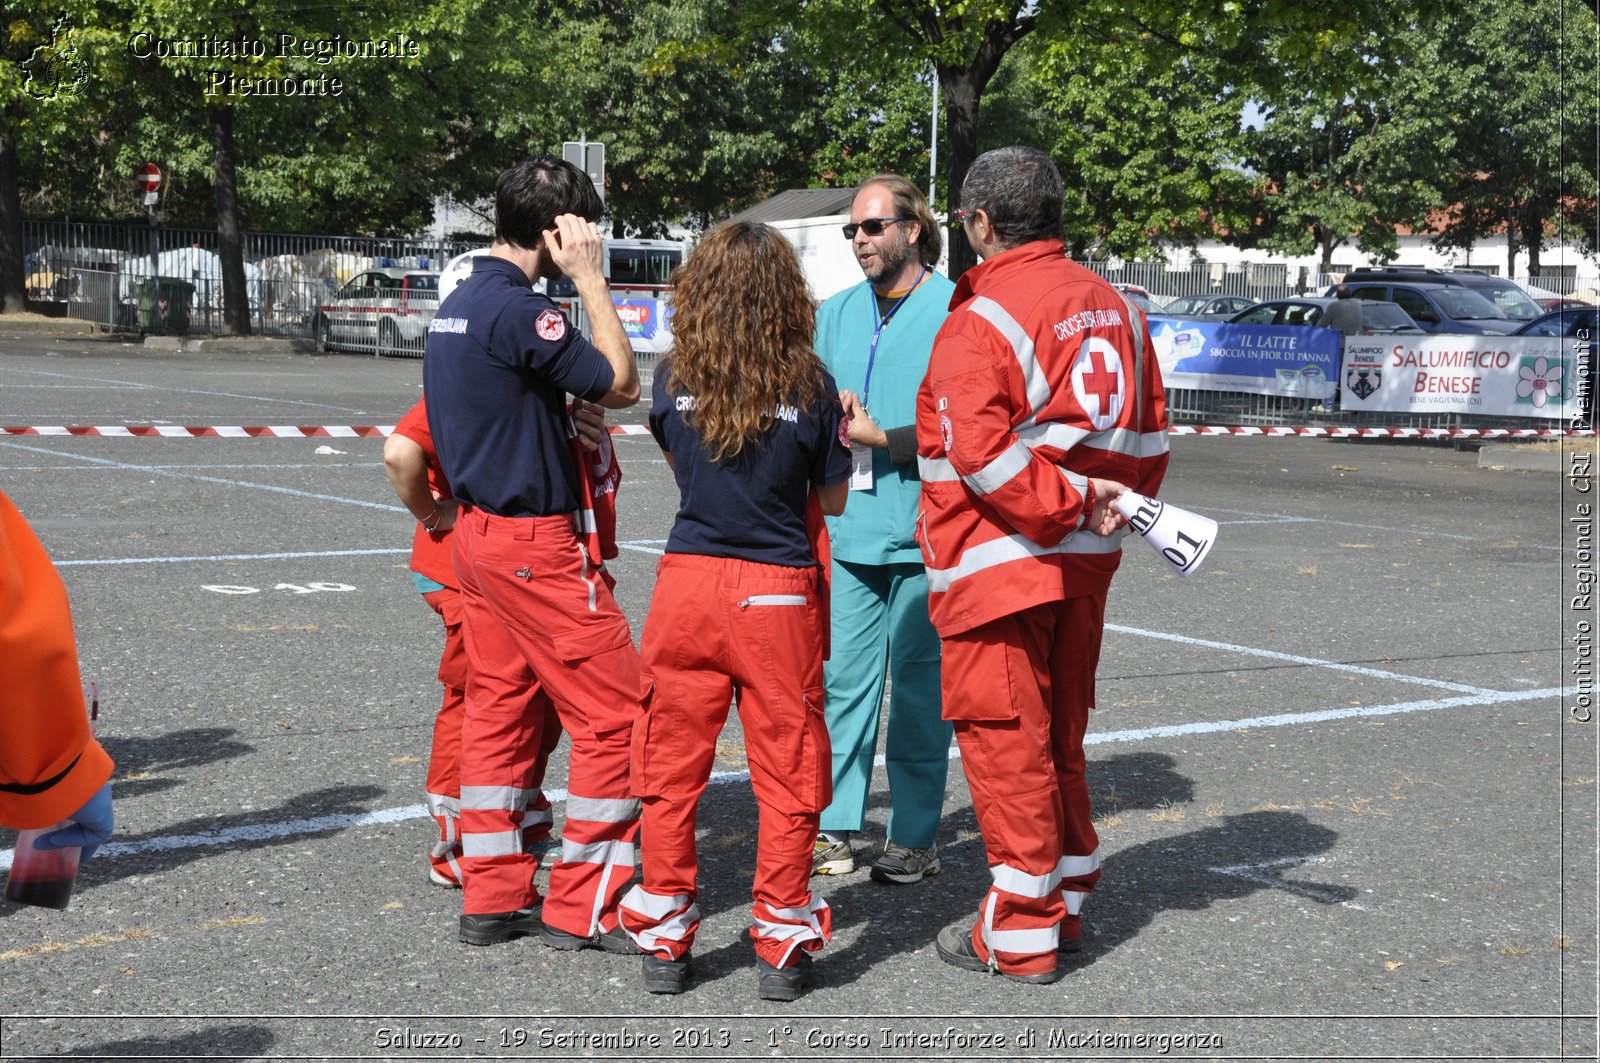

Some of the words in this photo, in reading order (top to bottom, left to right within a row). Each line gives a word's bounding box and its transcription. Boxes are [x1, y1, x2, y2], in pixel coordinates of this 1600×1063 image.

[1054, 314, 1086, 341] CROCE
[1241, 335, 1253, 348] IL
[1257, 336, 1297, 350] LATTE
[1209, 347, 1246, 359] SBOCCIA
[1248, 350, 1258, 360] IN
[1261, 351, 1281, 361] FIOR
[1284, 352, 1295, 362] DI
[1297, 353, 1331, 364] PANNA
[1392, 345, 1511, 369] SALUMIFICIO
[1413, 372, 1483, 395] BENESE
[1409, 396, 1427, 405] BENE
[1429, 396, 1466, 406] VAGIENNA
[1467, 397, 1482, 407] (CN)
[1162, 530, 1204, 567] 01
